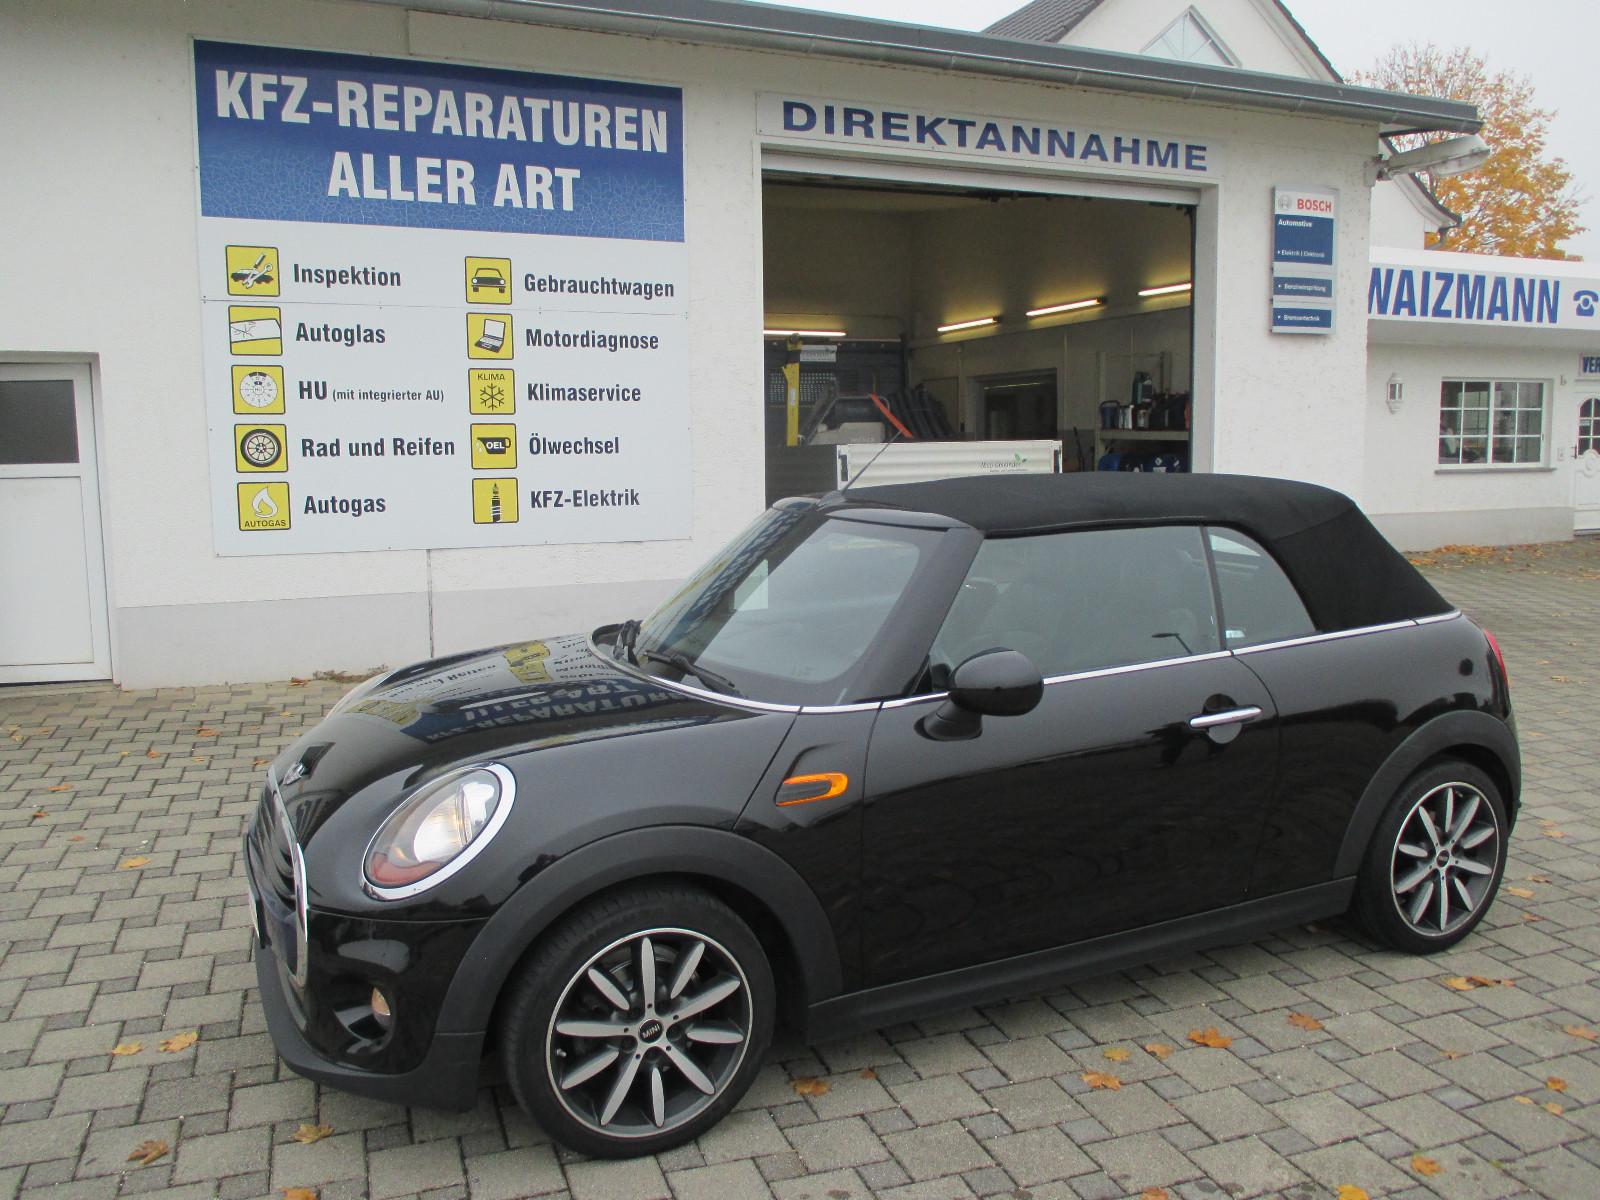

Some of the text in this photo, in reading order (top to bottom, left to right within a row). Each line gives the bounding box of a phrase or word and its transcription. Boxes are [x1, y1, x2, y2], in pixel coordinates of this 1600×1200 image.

[214, 69, 668, 153] KFZ-REPARATUREN
[782, 101, 1208, 172] DIREKTANNAHME
[327, 151, 581, 212] ALLER ART
[1297, 198, 1332, 212] BOSCH
[1278, 219, 1313, 228] Automotive
[293, 263, 401, 289] Inspektion
[524, 273, 675, 301] Gebrauchtwagen
[296, 322, 386, 347] Autoglas
[525, 328, 659, 352] Motordiagnose
[477, 373, 505, 381] KLIMA
[299, 380, 445, 402] HU (mit integrierter AU)
[527, 383, 641, 401] Klimaservice
[301, 437, 455, 457] Rad und Reifen
[486, 441, 505, 449] OEL
[529, 433, 619, 455] Ölwechsel
[304, 495, 386, 517] Autogas
[530, 488, 640, 508] KFZ-Elektrik
[244, 520, 287, 528] AUTOGAS
[643, 1023, 660, 1038] MINI
